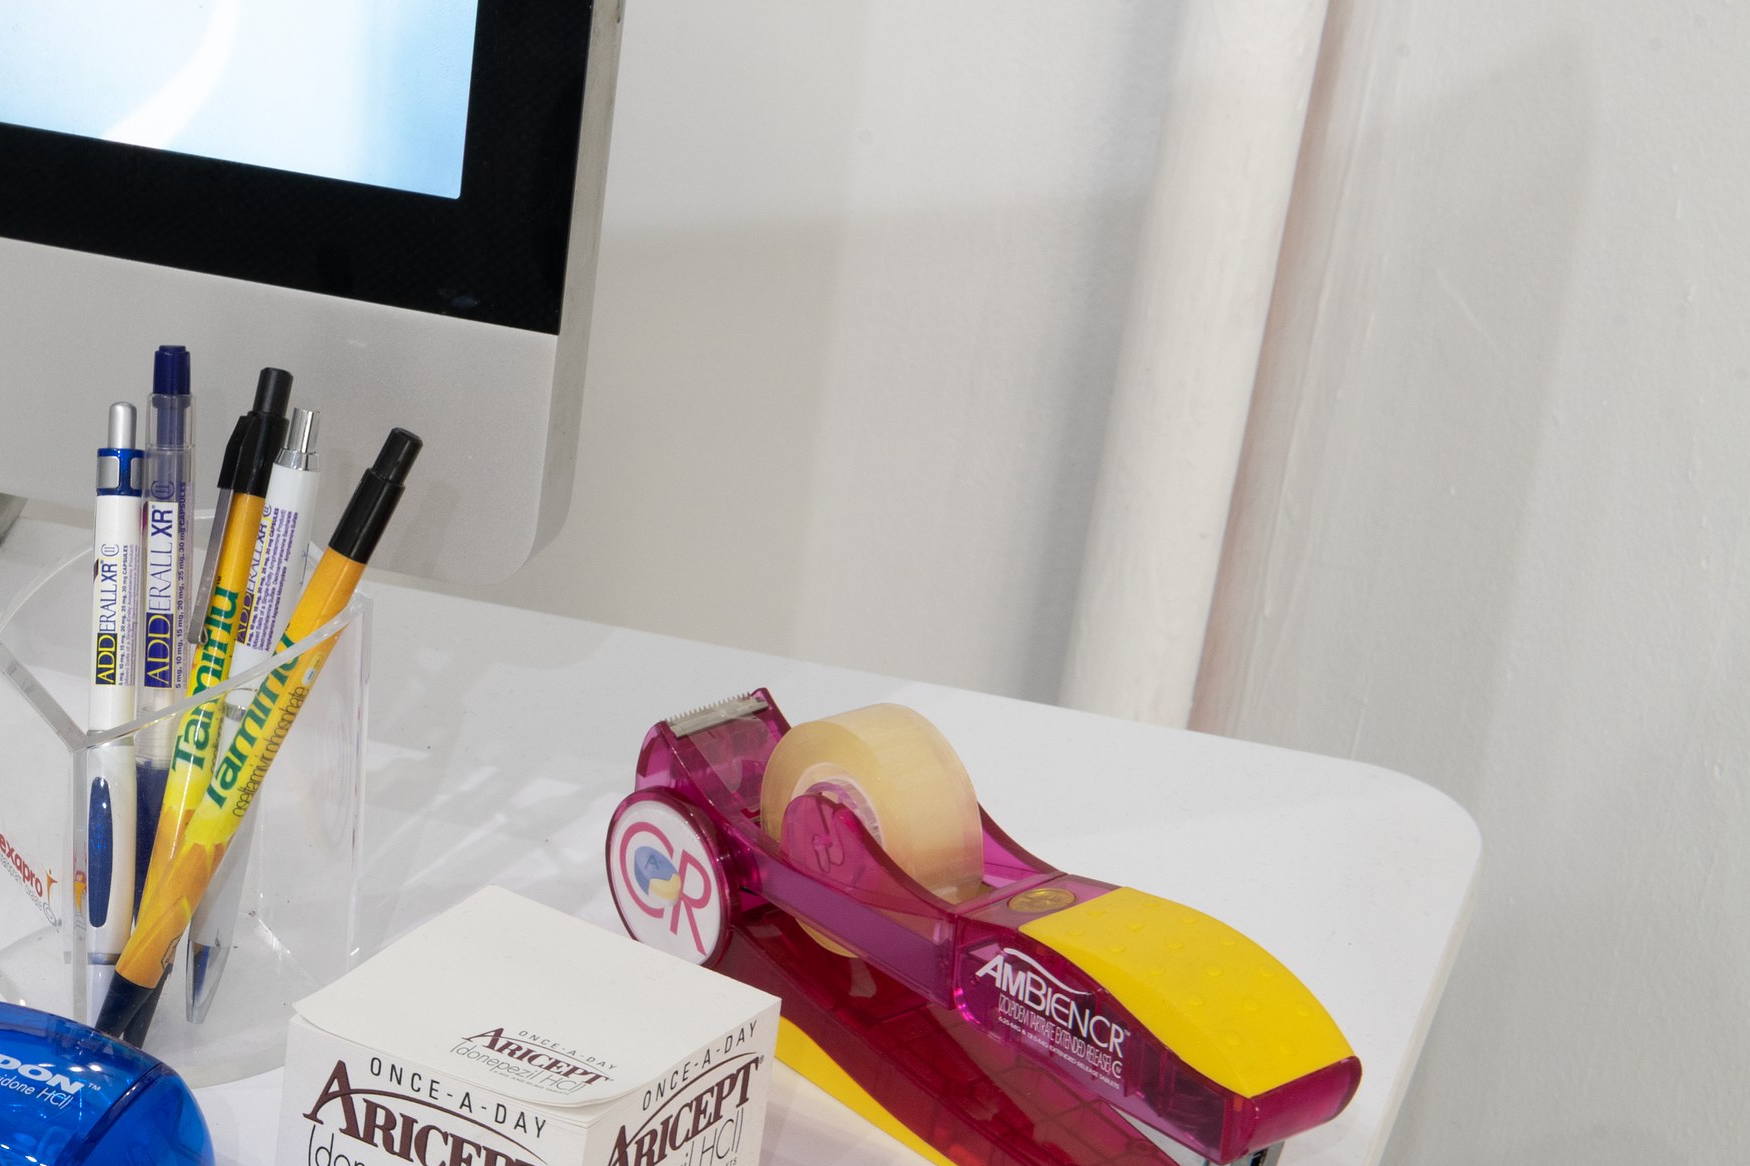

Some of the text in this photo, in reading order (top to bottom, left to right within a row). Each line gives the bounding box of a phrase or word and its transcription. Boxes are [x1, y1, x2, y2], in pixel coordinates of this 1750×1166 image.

[518, 1029, 617, 1072] ONCE-A-DAY
[642, 1020, 758, 1112] ONCE-A-DAY
[369, 1056, 547, 1139] ONCE-A-DAY
